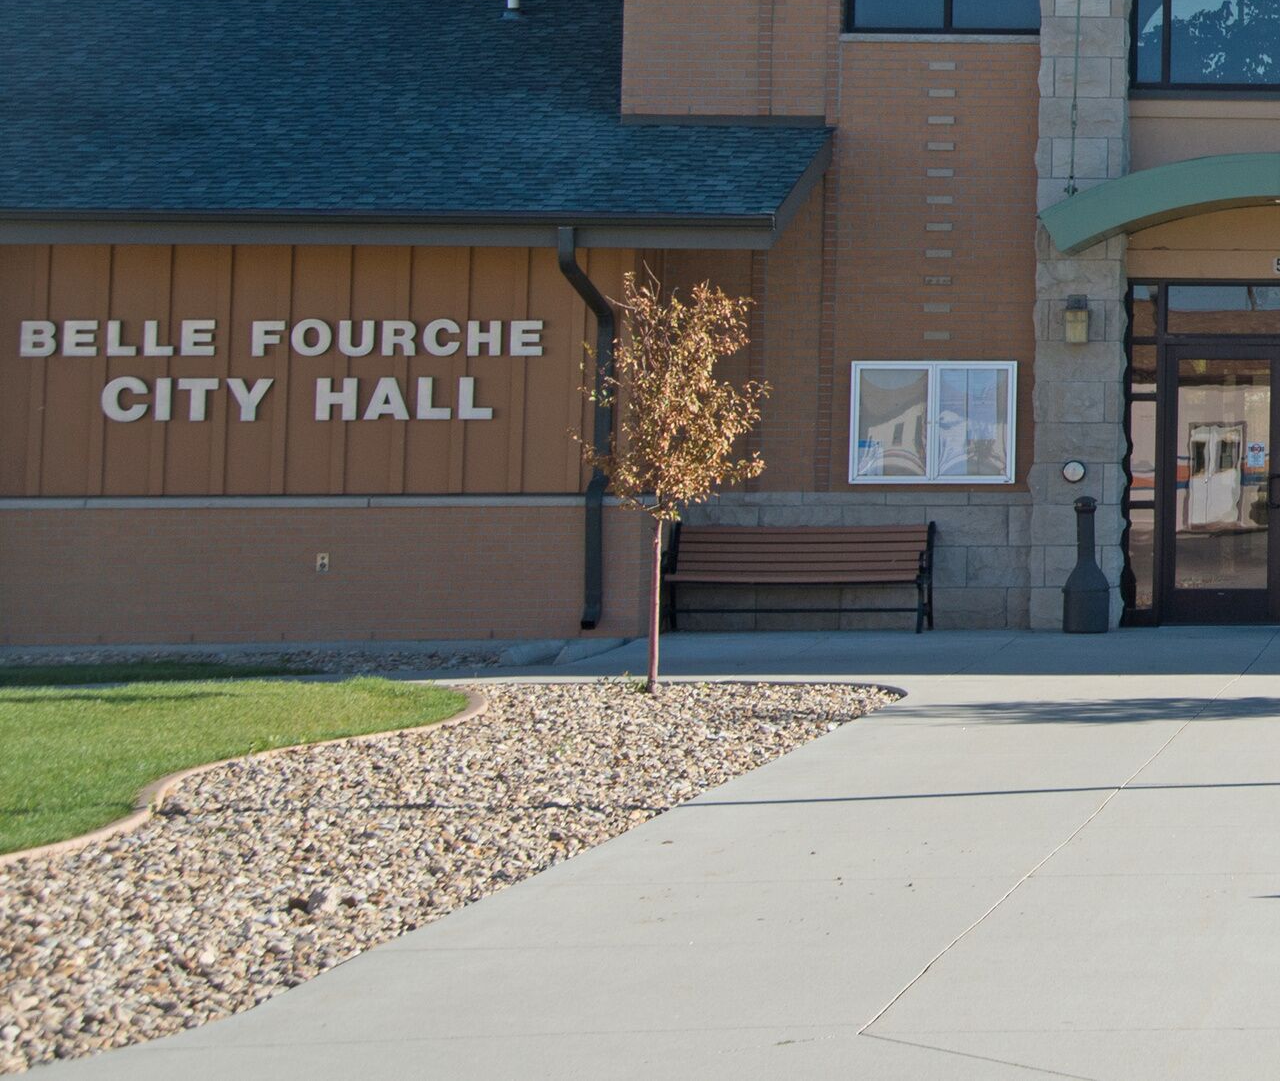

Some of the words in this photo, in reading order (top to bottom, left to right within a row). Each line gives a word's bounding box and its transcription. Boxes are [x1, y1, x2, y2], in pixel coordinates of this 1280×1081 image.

[19, 320, 216, 357] BELLE
[251, 319, 544, 357] FOURCHE
[101, 376, 274, 421] CITY
[314, 377, 493, 420] HALL
